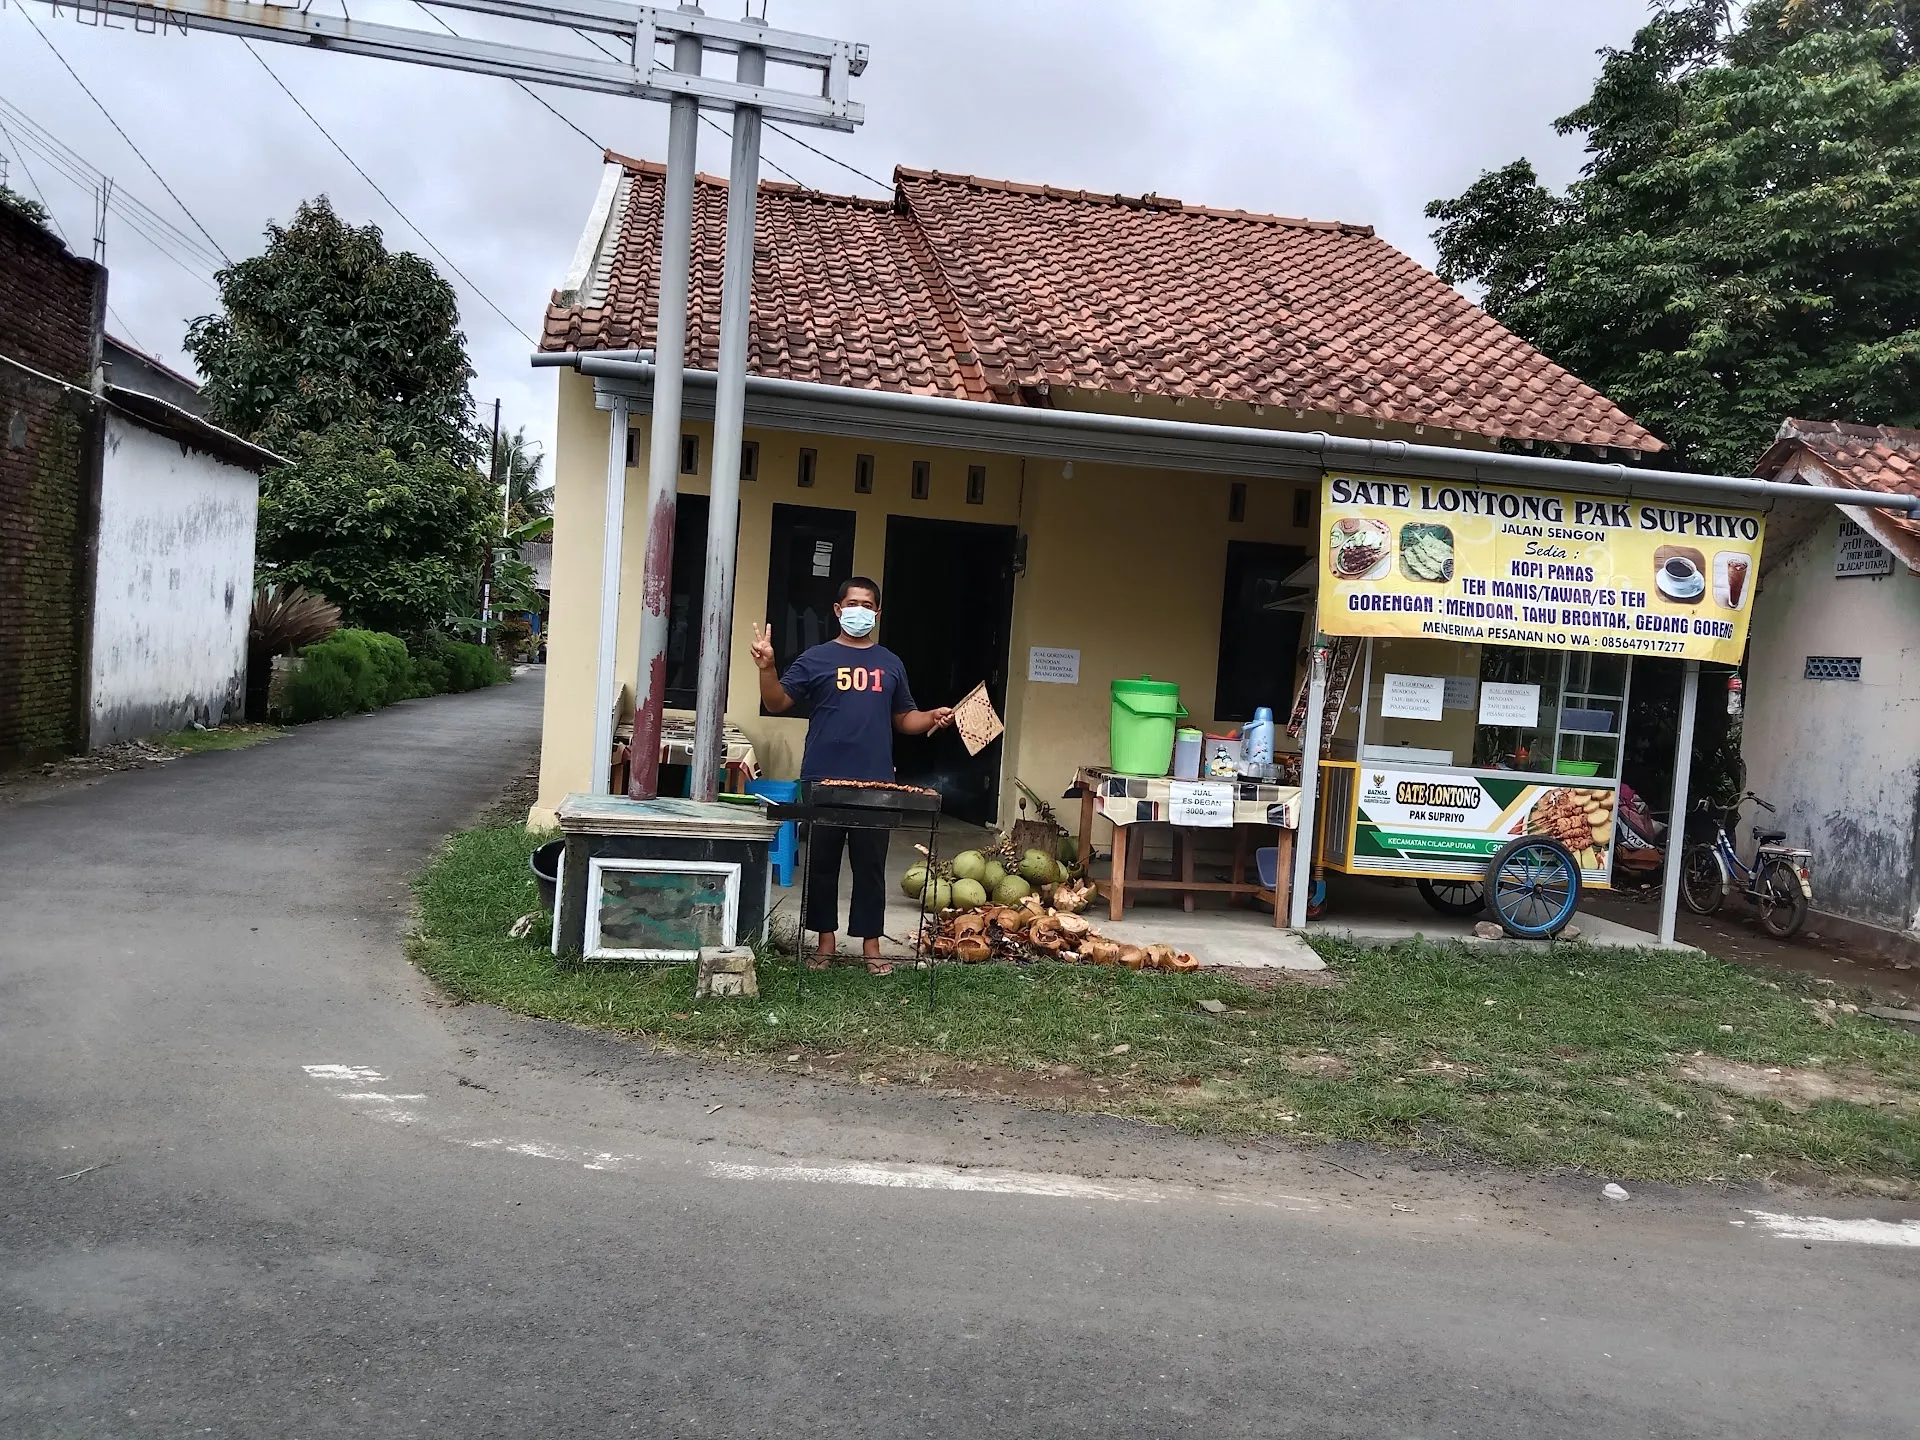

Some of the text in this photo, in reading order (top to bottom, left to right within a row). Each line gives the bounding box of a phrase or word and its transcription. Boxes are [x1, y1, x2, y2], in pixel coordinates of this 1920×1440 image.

[1332, 478, 1759, 541] SATE LONTONG PAK SUPRIYO
[1501, 523, 1605, 542] JALAN SENGON
[1525, 541, 1567, 559] Sedia
[1511, 560, 1594, 582] KOPI PANAS
[1462, 578, 1646, 608] TEH MANIS/TAWAR/ES TEH
[1349, 594, 1433, 612] GORENGAN
[1446, 599, 1518, 622] MENDOAN,
[1522, 606, 1556, 624] TAHU
[1562, 609, 1631, 631] BRONTAK,
[1635, 614, 1689, 634] GEDANG
[1693, 620, 1734, 640] GORENG
[1422, 621, 1484, 638] MENERIMA
[1488, 627, 1543, 643] PESANAN
[1547, 632, 1566, 645] NO
[1570, 634, 1590, 646] WA
[1601, 636, 1685, 653] 085647917277
[836, 667, 883, 692] 501
[1182, 797, 1222, 806] ES DEGAN
[1192, 789, 1212, 797] JUAL
[1397, 782, 1480, 808] SATE LONTONG
[1409, 810, 1465, 823] PAK SUPRIYO
[1387, 837, 1476, 850] KECAMATAN CILACAP UTARA
